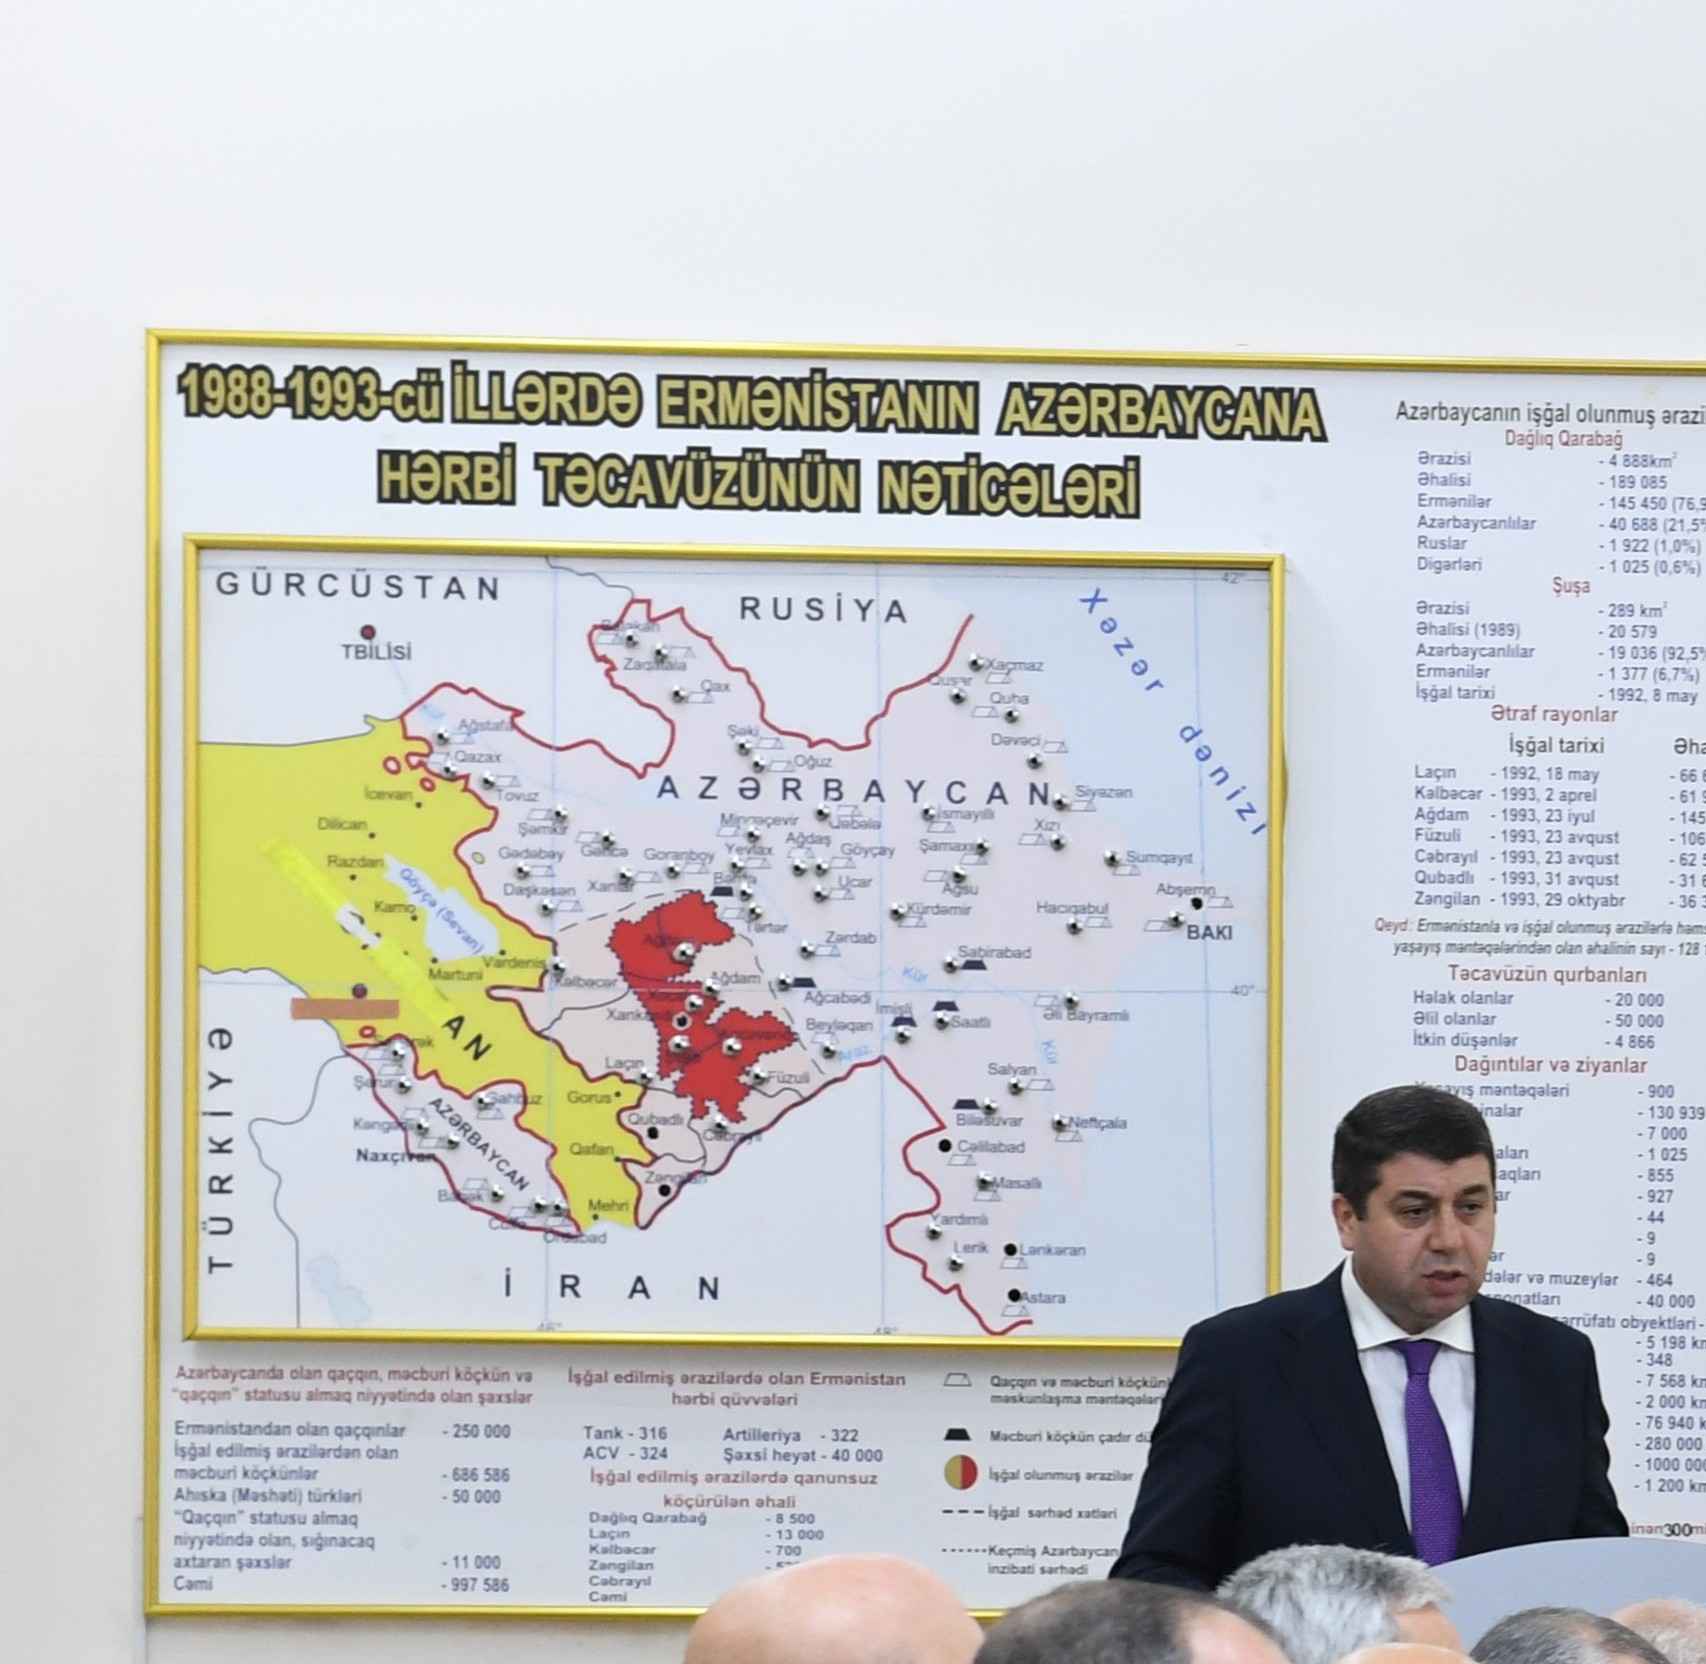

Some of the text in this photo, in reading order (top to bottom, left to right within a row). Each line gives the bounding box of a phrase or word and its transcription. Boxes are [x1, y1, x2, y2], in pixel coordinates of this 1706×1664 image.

[178, 360, 1328, 442] 1988-1993-cü İLLƏRDƏ ERMƏNİSTANIN AZƏRBAYCANA
[1396, 401, 1520, 426] Azərbaycanın
[1527, 402, 1570, 427] işğal
[1576, 404, 1655, 431] olunmuş
[1505, 426, 1623, 451] Dağlıq Qarabağ
[378, 443, 1141, 519] HƏRBİ TƏCAVÜZÜNÜN NƏTİCƏLƏRİ
[217, 567, 499, 600] GÜRCÜSTAN
[1553, 576, 1590, 597] Şuşa
[740, 592, 907, 623] RUSİYA
[341, 638, 411, 660] TBİLİSİ
[1079, 588, 1164, 692] Xəzər
[1491, 704, 1619, 726] Ətraf rayonlar
[1510, 733, 1552, 757] İşğal
[1559, 737, 1604, 753] tarixi
[453, 750, 502, 763] Qazax
[657, 775, 1050, 806] AZƏRBAYCAN
[1184, 922, 1232, 940] BAKI
[1448, 964, 1647, 985] Təcavüzün qurbanları
[1549, 1060, 1570, 1072] və
[1576, 1056, 1648, 1077] ziyanlar
[200, 1027, 234, 1274] TÜRKİYƏ
[505, 1267, 719, 1300] İRAN
[1647, 1353, 1672, 1367] 348
[584, 1426, 667, 1440] Tank 316
[831, 1429, 859, 1442] 322
[640, 1447, 668, 1460] 324
[1664, 1522, 1692, 1538] 300
